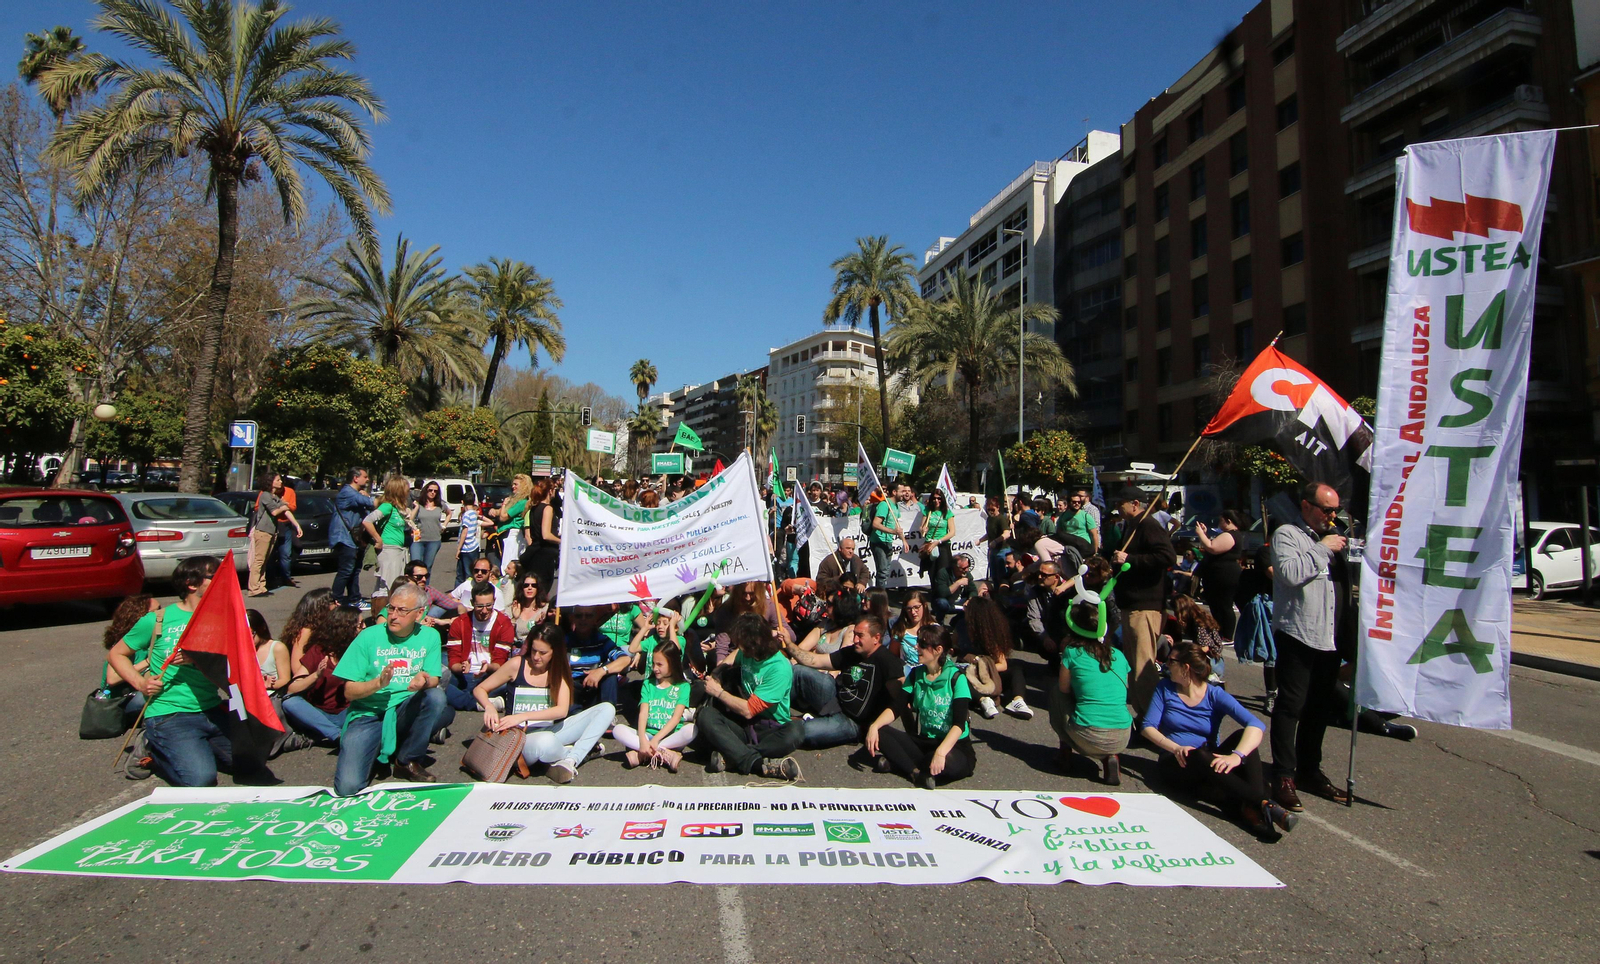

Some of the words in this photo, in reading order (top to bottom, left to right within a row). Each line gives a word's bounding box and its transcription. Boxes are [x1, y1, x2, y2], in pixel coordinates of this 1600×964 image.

[1407, 241, 1531, 277] USTEA
[1399, 305, 1430, 444] ANDALUZA
[1295, 431, 1328, 456] AIT
[1406, 290, 1505, 674] USTEA
[624, 509, 679, 523] LORCA
[653, 533, 685, 546] ESCUELA
[580, 557, 590, 565] EL
[591, 555, 616, 564] GARCÍA
[617, 554, 640, 563] LORCA
[598, 565, 640, 579] TODOS
[646, 554, 687, 570] SOMOS
[692, 541, 736, 560] IGUALES.
[376, 647, 405, 657] ESCUELA
[406, 648, 427, 659] PÚBLIC
[490, 801, 504, 811] NO
[504, 801, 515, 810] A
[513, 801, 532, 811] LOS
[532, 801, 581, 811] RECORTES
[586, 801, 601, 811] NO
[602, 802, 609, 811] A
[610, 802, 622, 811] LA
[662, 800, 675, 809] NO
[676, 802, 683, 811] A
[684, 802, 695, 811] LA
[697, 802, 760, 811] PRECARIEDAD
[770, 802, 788, 811] NO
[791, 802, 800, 811] A
[802, 801, 817, 811] LA
[820, 801, 916, 812] PRIVATIZACIÓN
[930, 810, 948, 819] DE
[950, 809, 966, 819] LA
[965, 798, 1058, 820] YO
[159, 820, 233, 836] DE
[624, 830, 662, 839] CGT
[683, 825, 743, 835] CNT
[1044, 821, 1149, 838] Escuela
[935, 824, 1012, 853] ENSEÑANZA
[75, 845, 206, 864] PARA
[213, 845, 373, 872] TOD@S
[429, 850, 552, 868] ¡DINERO
[569, 850, 685, 866] PÚBLICO
[699, 853, 756, 865] PARA
[765, 853, 790, 865] LA
[798, 847, 938, 868] PÚBLICA!
[1070, 855, 1103, 872] la
